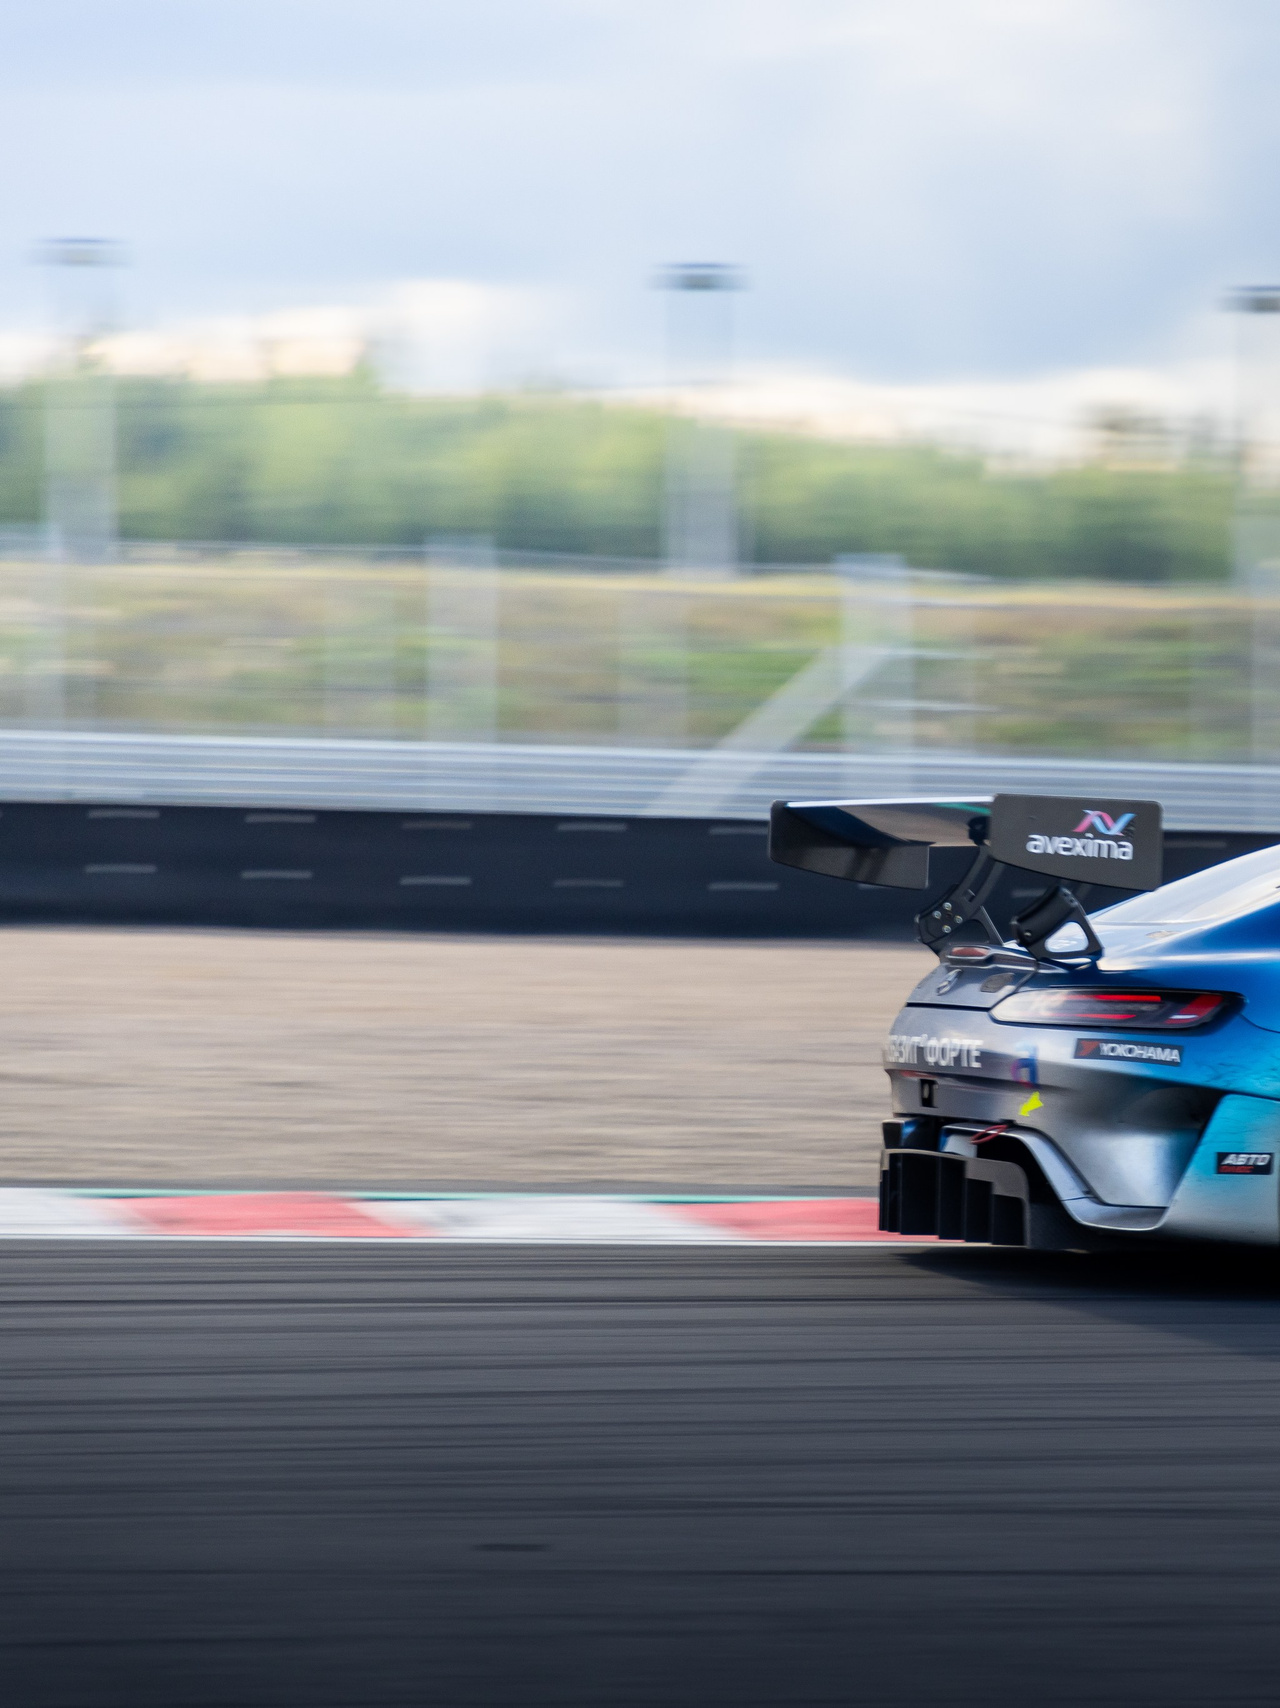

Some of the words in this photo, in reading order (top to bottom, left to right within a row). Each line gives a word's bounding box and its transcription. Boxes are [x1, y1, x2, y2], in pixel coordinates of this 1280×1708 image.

[1026, 833, 1133, 860] avexima
[924, 1036, 984, 1068] ФОРТЕ
[1099, 1042, 1181, 1062] YOKOHAMA
